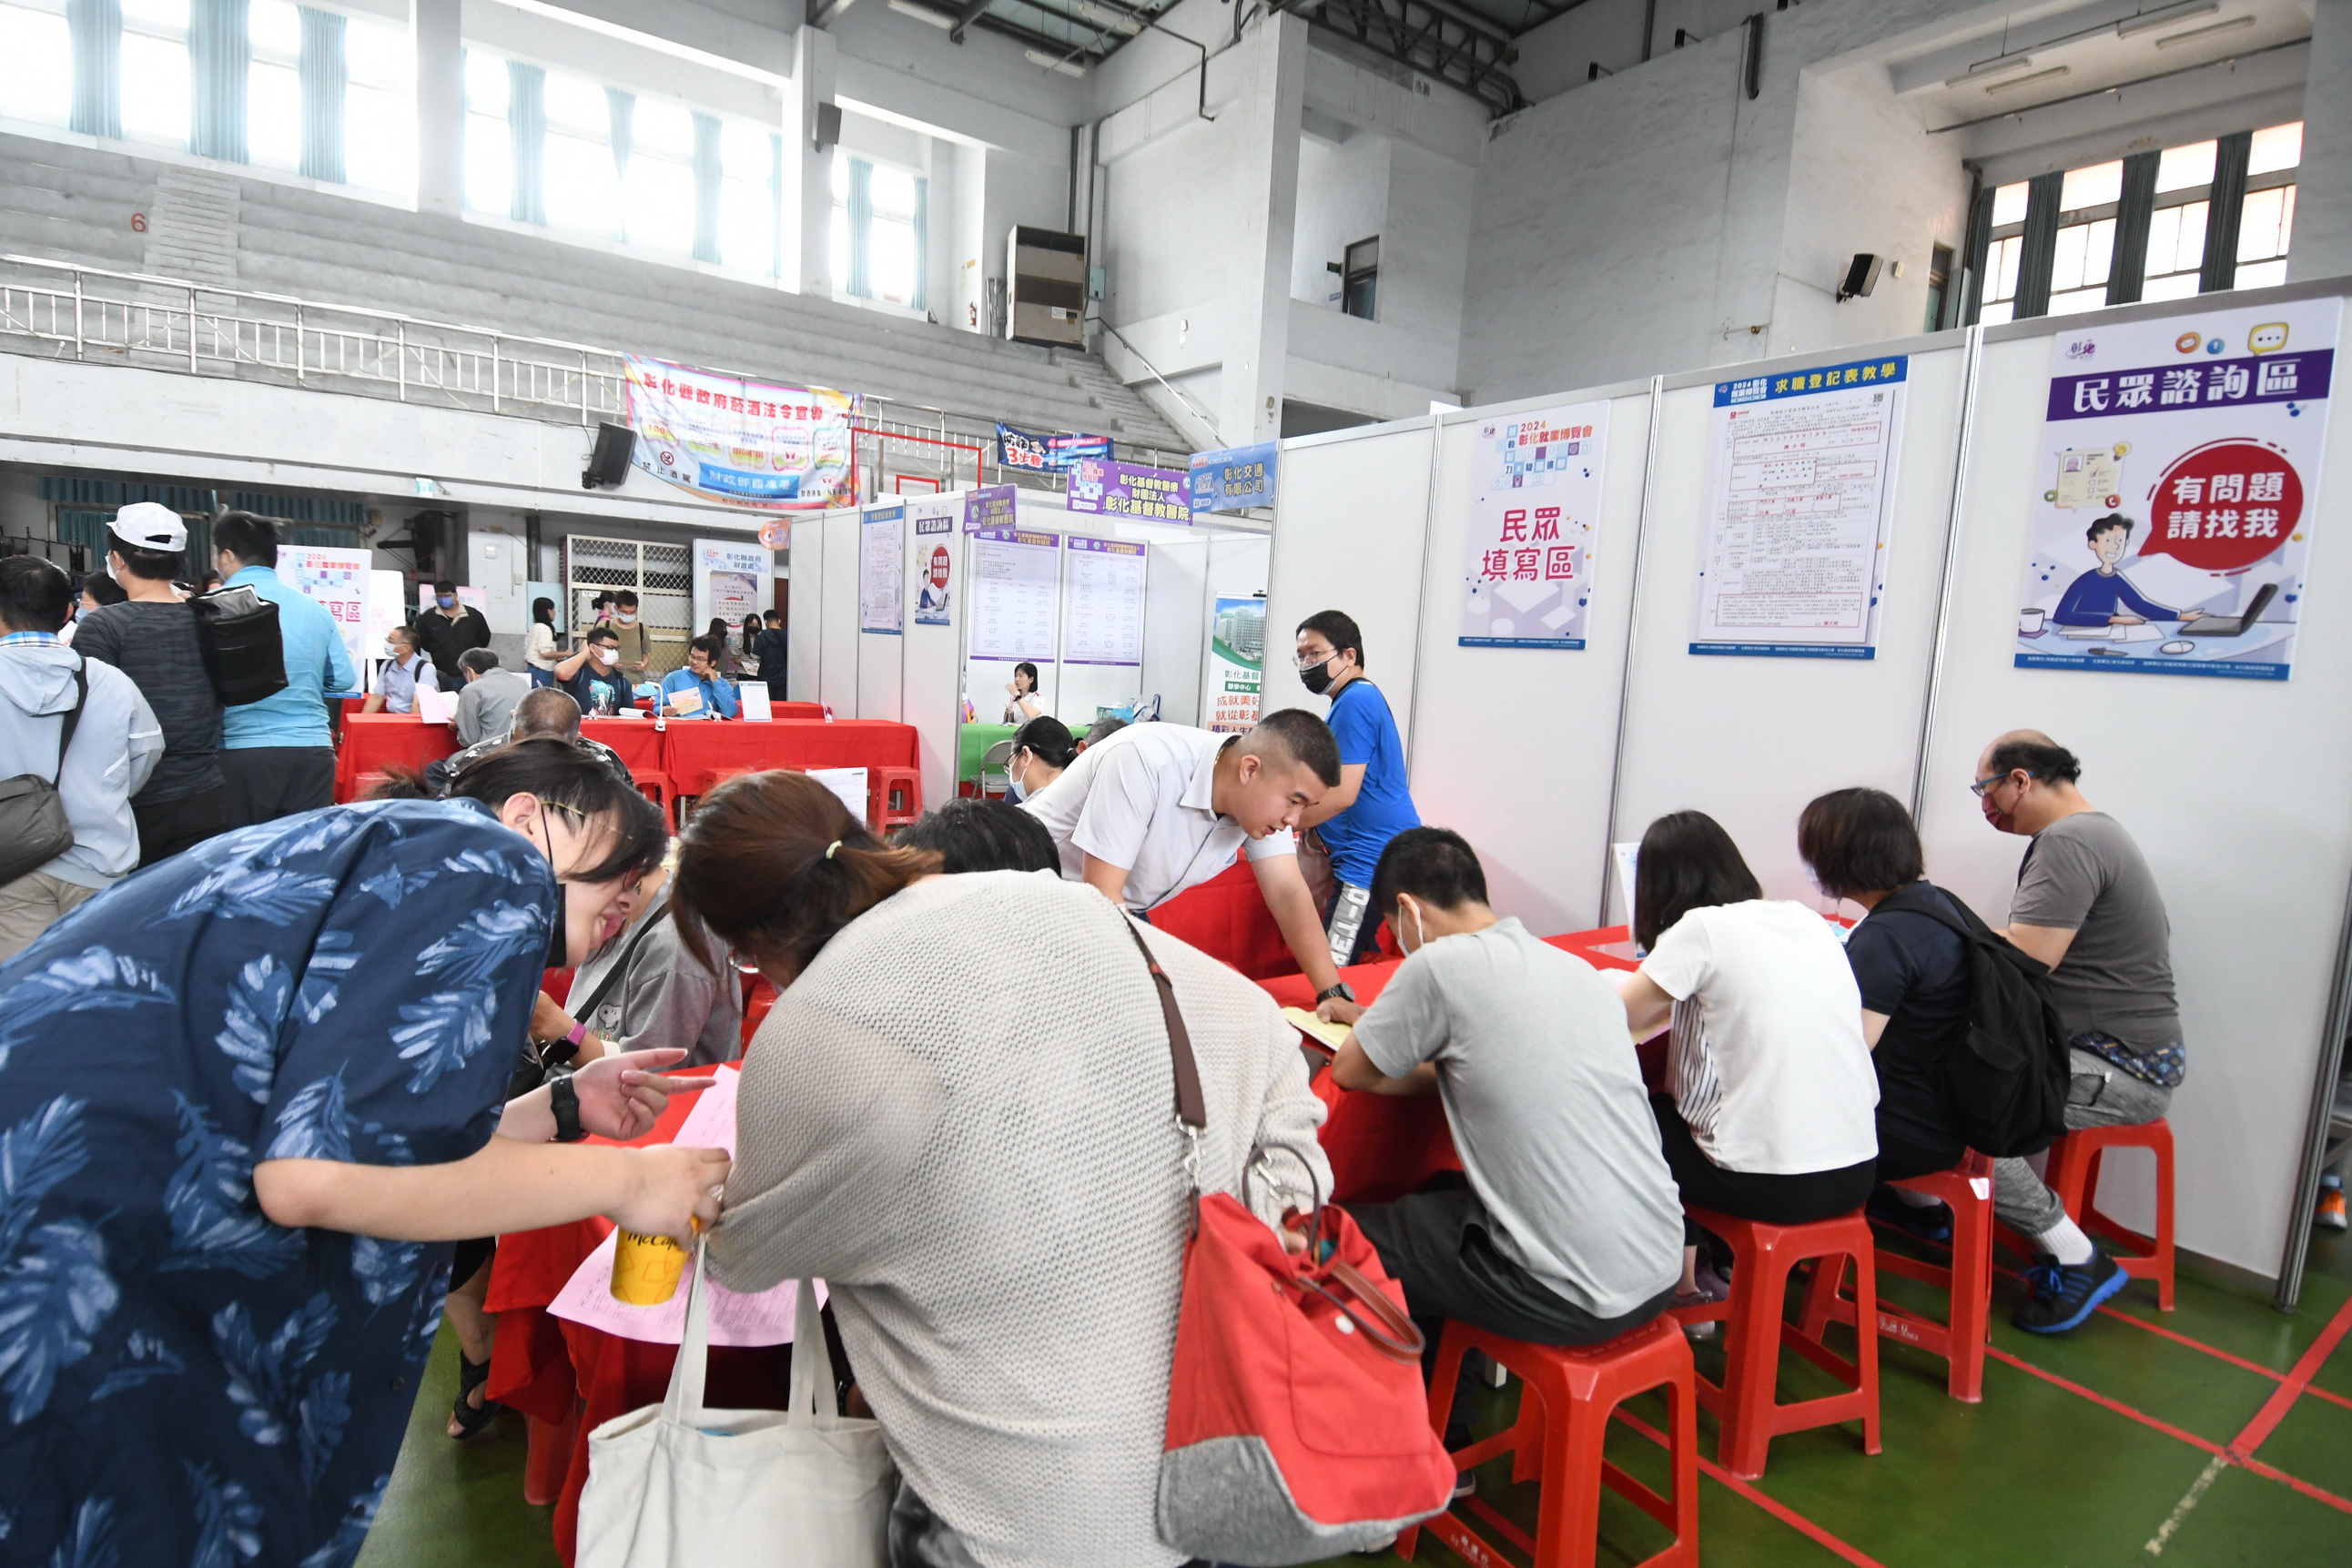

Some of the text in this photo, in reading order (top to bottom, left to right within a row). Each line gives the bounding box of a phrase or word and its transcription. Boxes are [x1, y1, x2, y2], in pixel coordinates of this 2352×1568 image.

[130, 212, 147, 233] 6
[1774, 362, 1897, 394] 求職登記表教學
[2073, 358, 2302, 413] 民眾諮詢區
[1518, 425, 1593, 446] 彰化就業博覽會
[1520, 420, 1546, 432] 2024
[1224, 462, 1264, 481] 彰化交通
[1120, 473, 1179, 492] 彰化基督教醫療
[1224, 479, 1264, 497] 有限公司
[2172, 470, 2286, 506] 有問題
[1131, 488, 1166, 502] 財團法人
[1104, 496, 1191, 521] 彰化基督教醫院
[1499, 506, 1561, 542] 民眾
[2166, 508, 2280, 541] 請找我
[1481, 545, 1576, 582] 填寫區
[319, 601, 361, 622] 寫區
[1216, 694, 1260, 707] 成就美好
